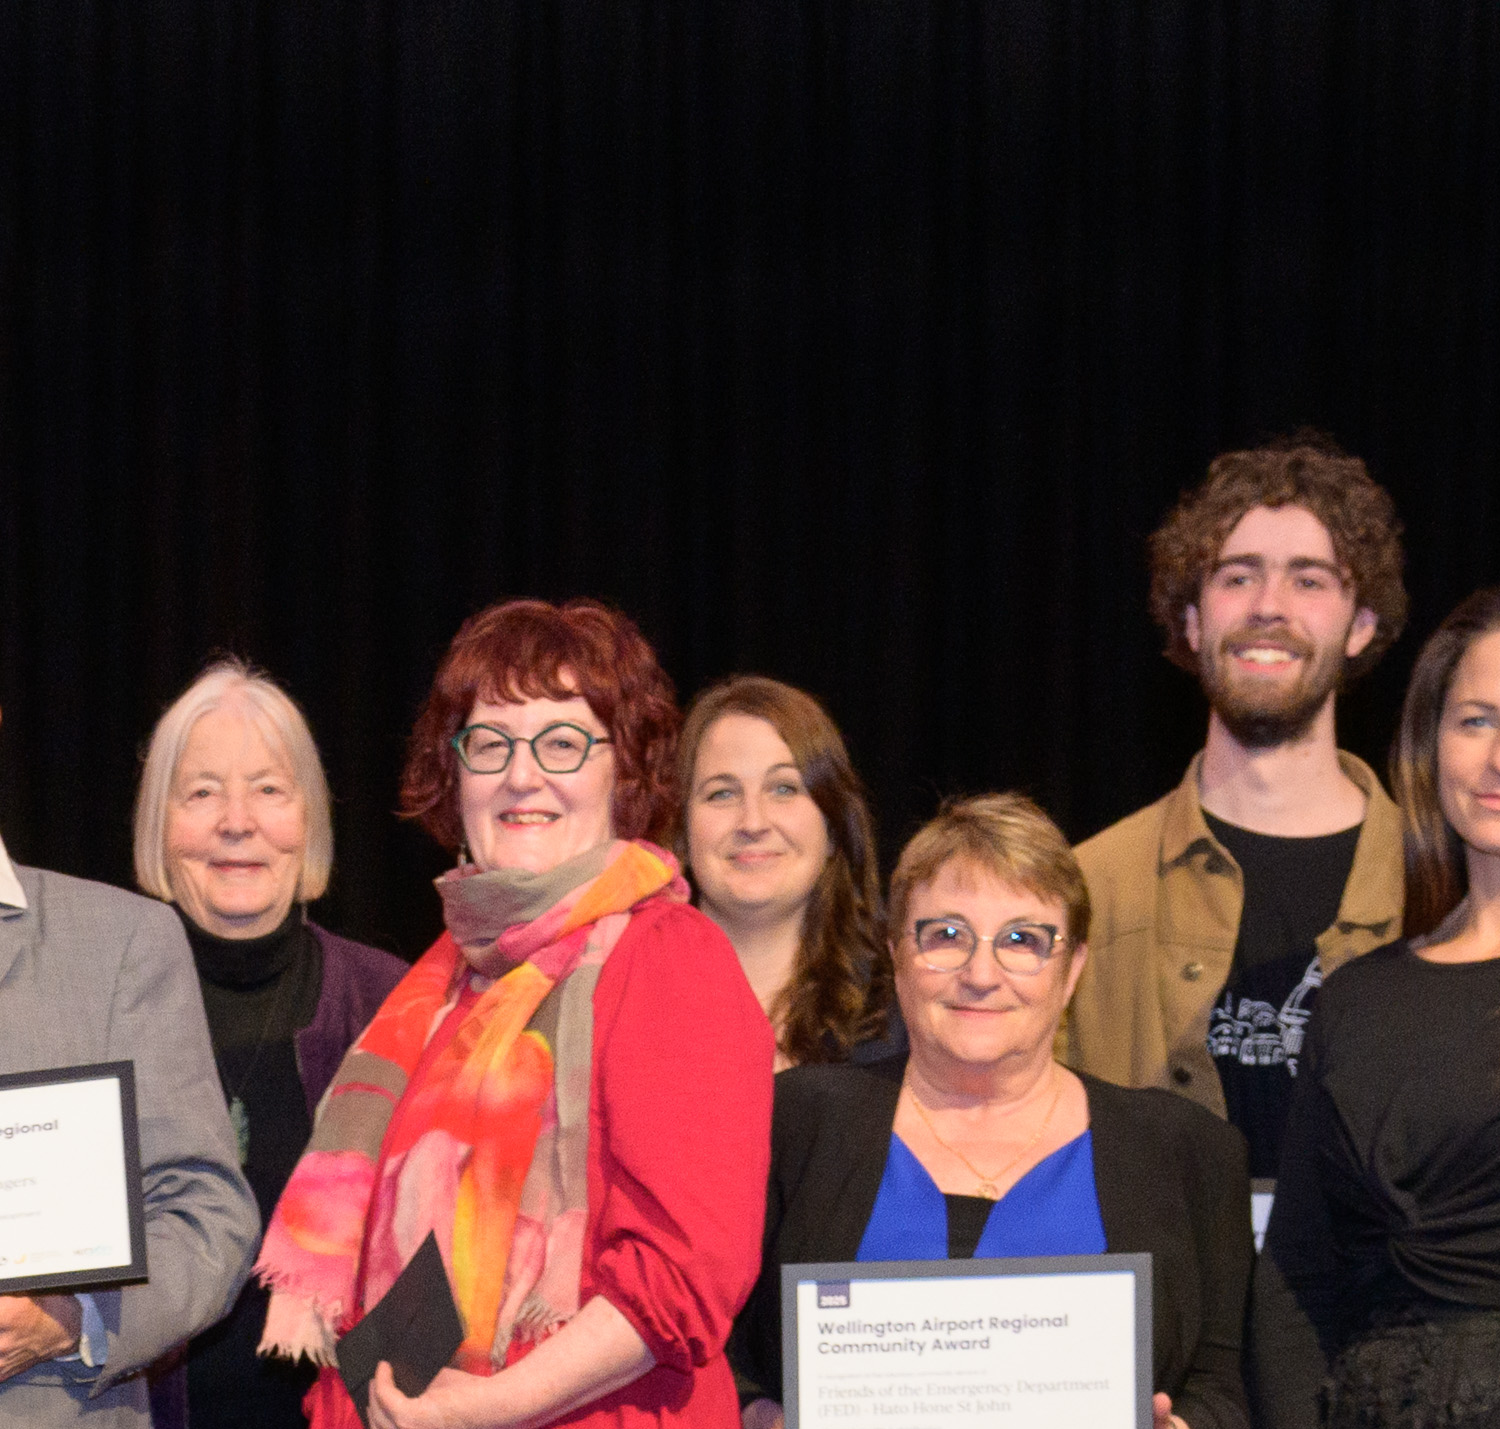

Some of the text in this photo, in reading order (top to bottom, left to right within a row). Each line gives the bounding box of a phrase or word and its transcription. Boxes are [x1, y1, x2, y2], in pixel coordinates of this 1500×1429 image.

[817, 1314, 1069, 1337] Wellington Airport Regional
[817, 1336, 991, 1356] Community Award
[818, 1377, 1111, 1399] Friends of the Emergency Department
[872, 1402, 909, 1416] Hato
[913, 1401, 953, 1415] Hone
[957, 1400, 972, 1413] St
[975, 1399, 1012, 1414] John
